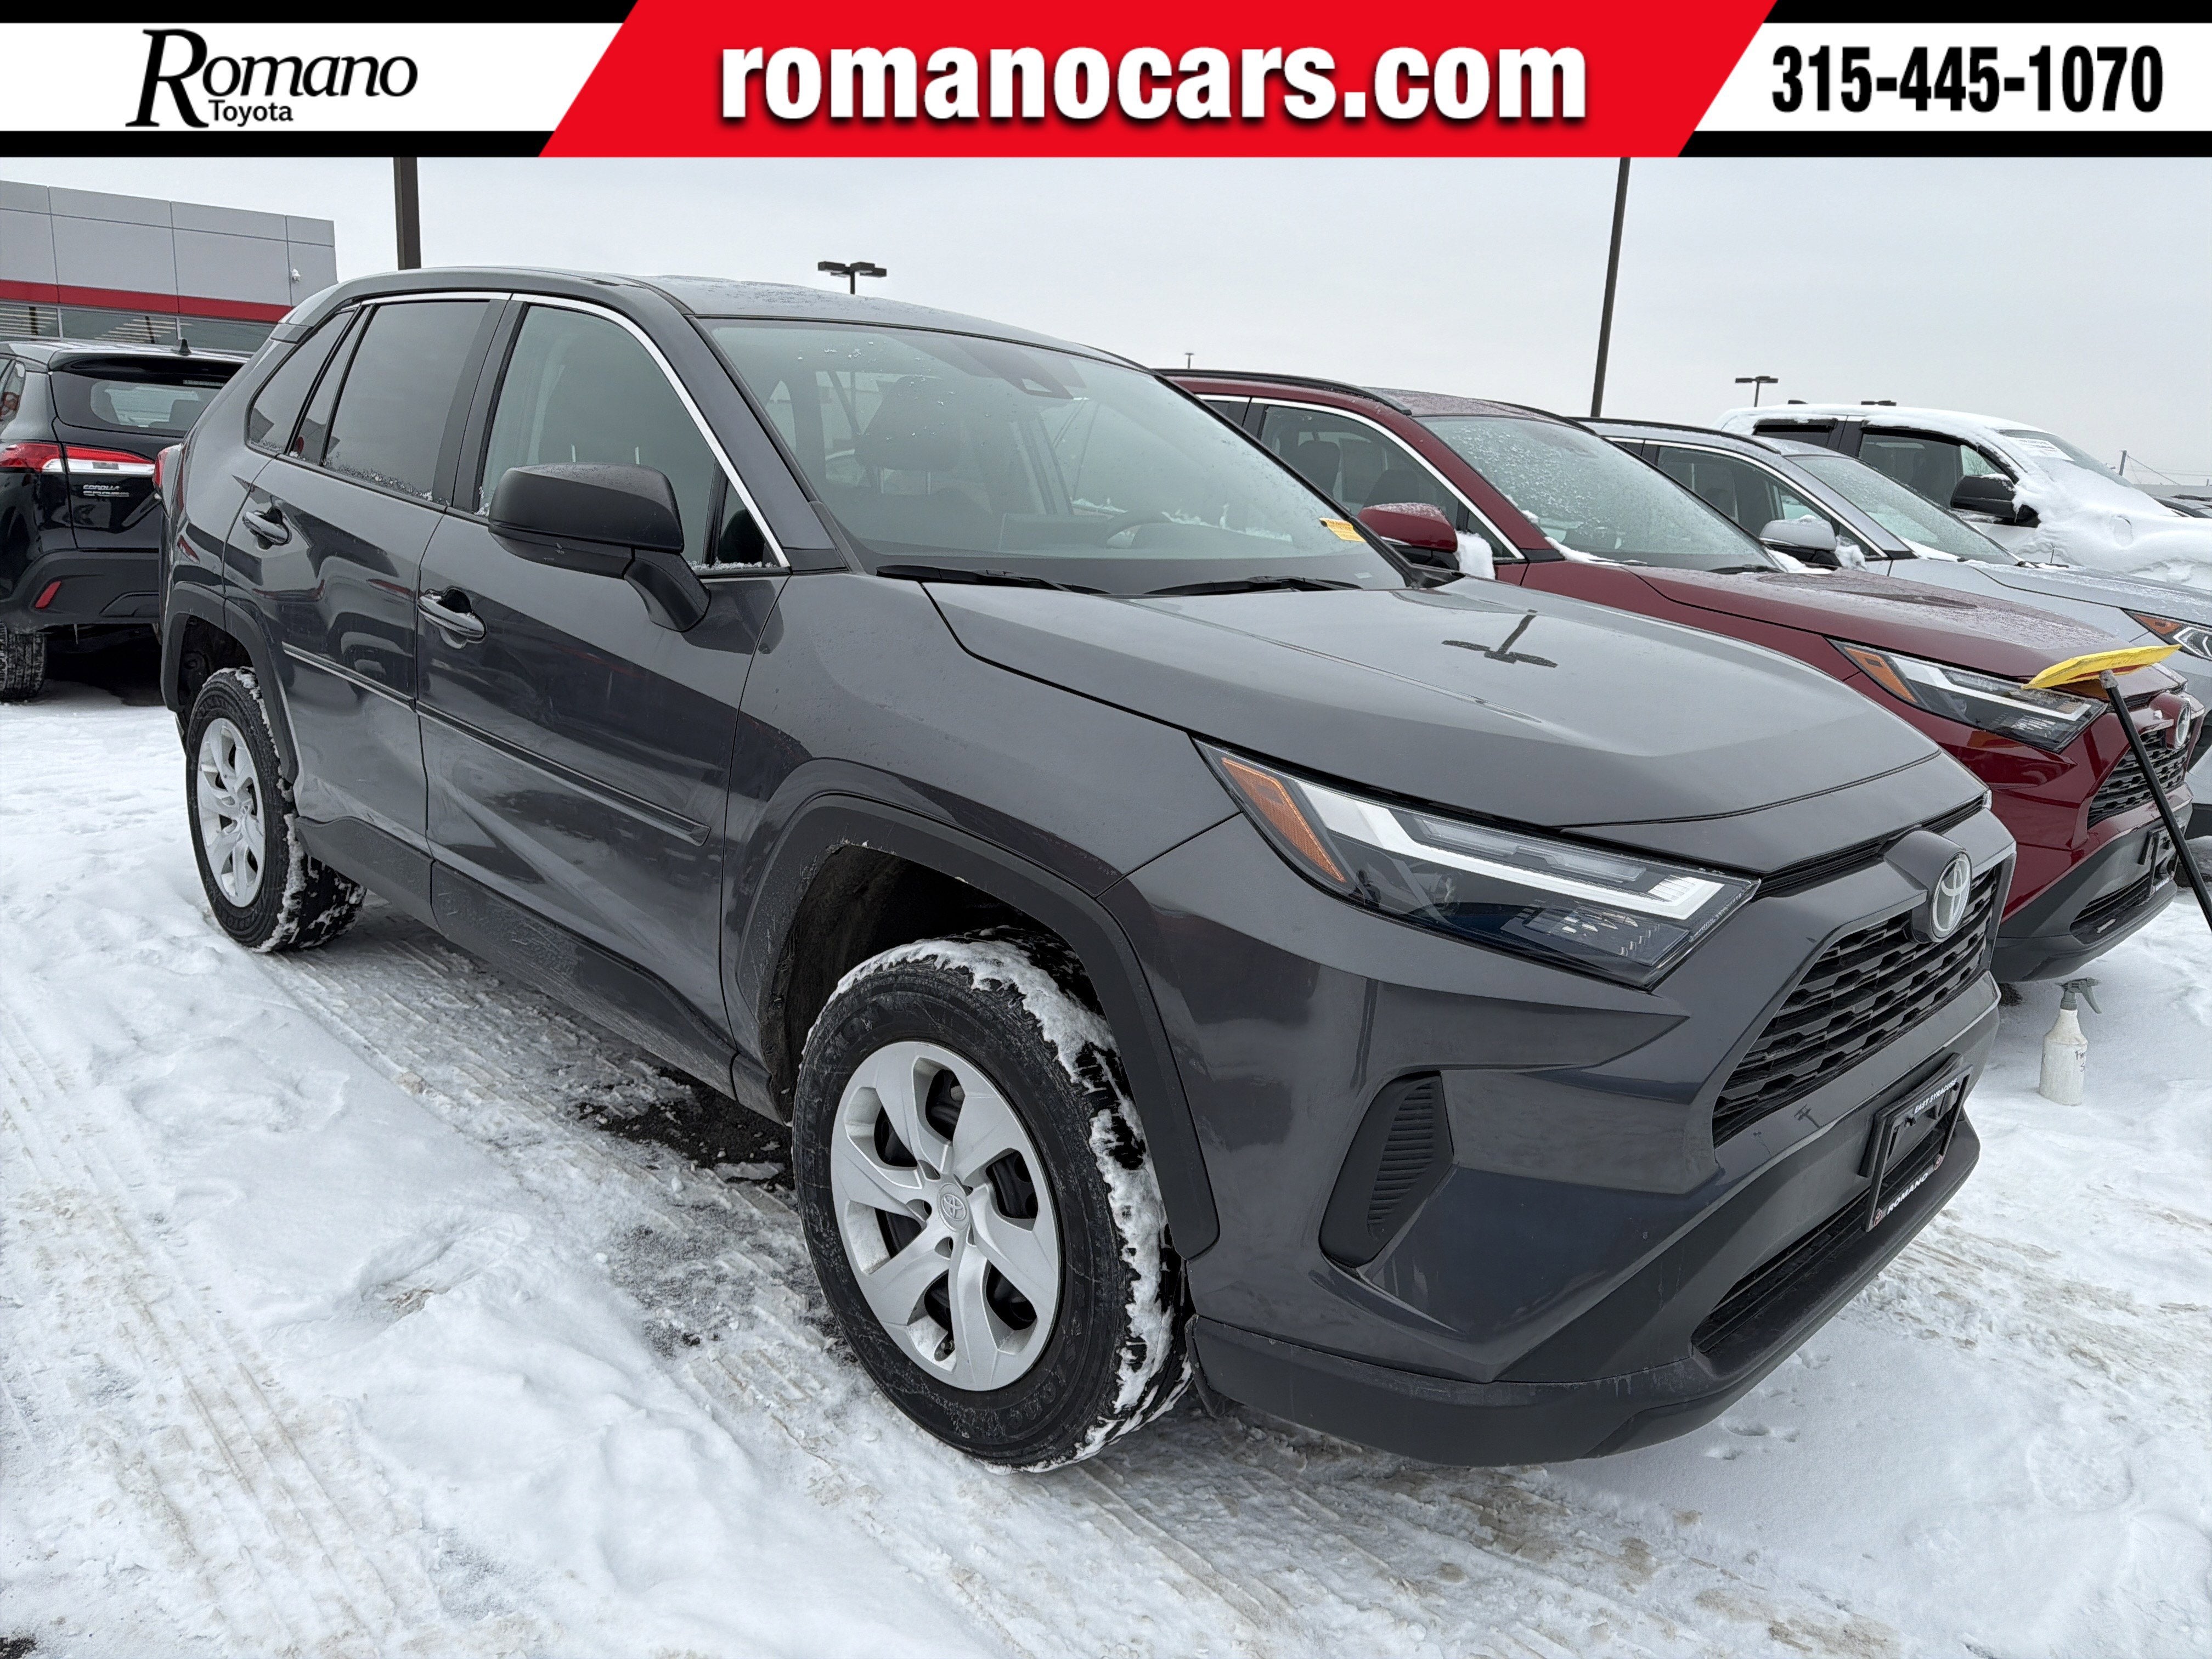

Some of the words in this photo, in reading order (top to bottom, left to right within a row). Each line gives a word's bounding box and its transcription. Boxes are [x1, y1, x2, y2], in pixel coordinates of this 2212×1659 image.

[1914, 1098, 1929, 1114] EAST
[1929, 1077, 1958, 1103] SYRACUSE
[1887, 1172, 1928, 1215] ROMANO
